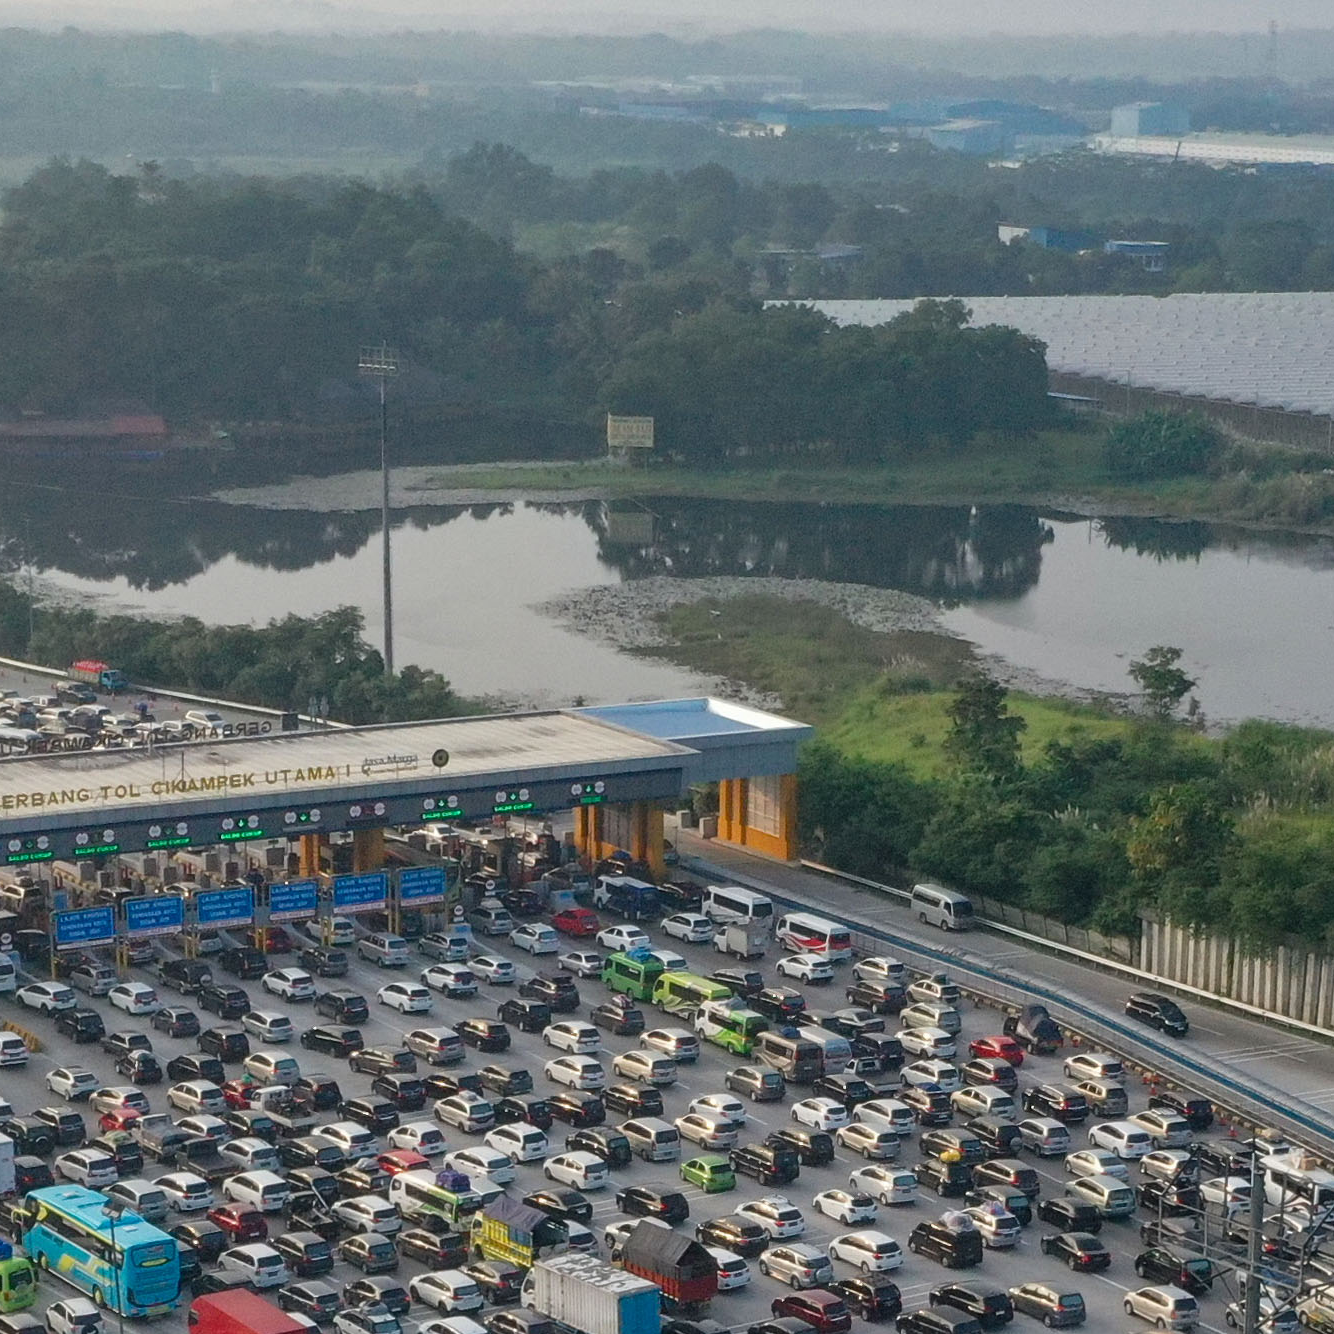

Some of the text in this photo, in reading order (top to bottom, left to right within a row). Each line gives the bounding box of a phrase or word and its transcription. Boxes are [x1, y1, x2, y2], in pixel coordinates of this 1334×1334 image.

[100, 783, 141, 799] TOL
[151, 773, 255, 795] CIKAMPEK
[265, 766, 336, 784] UTAMA
